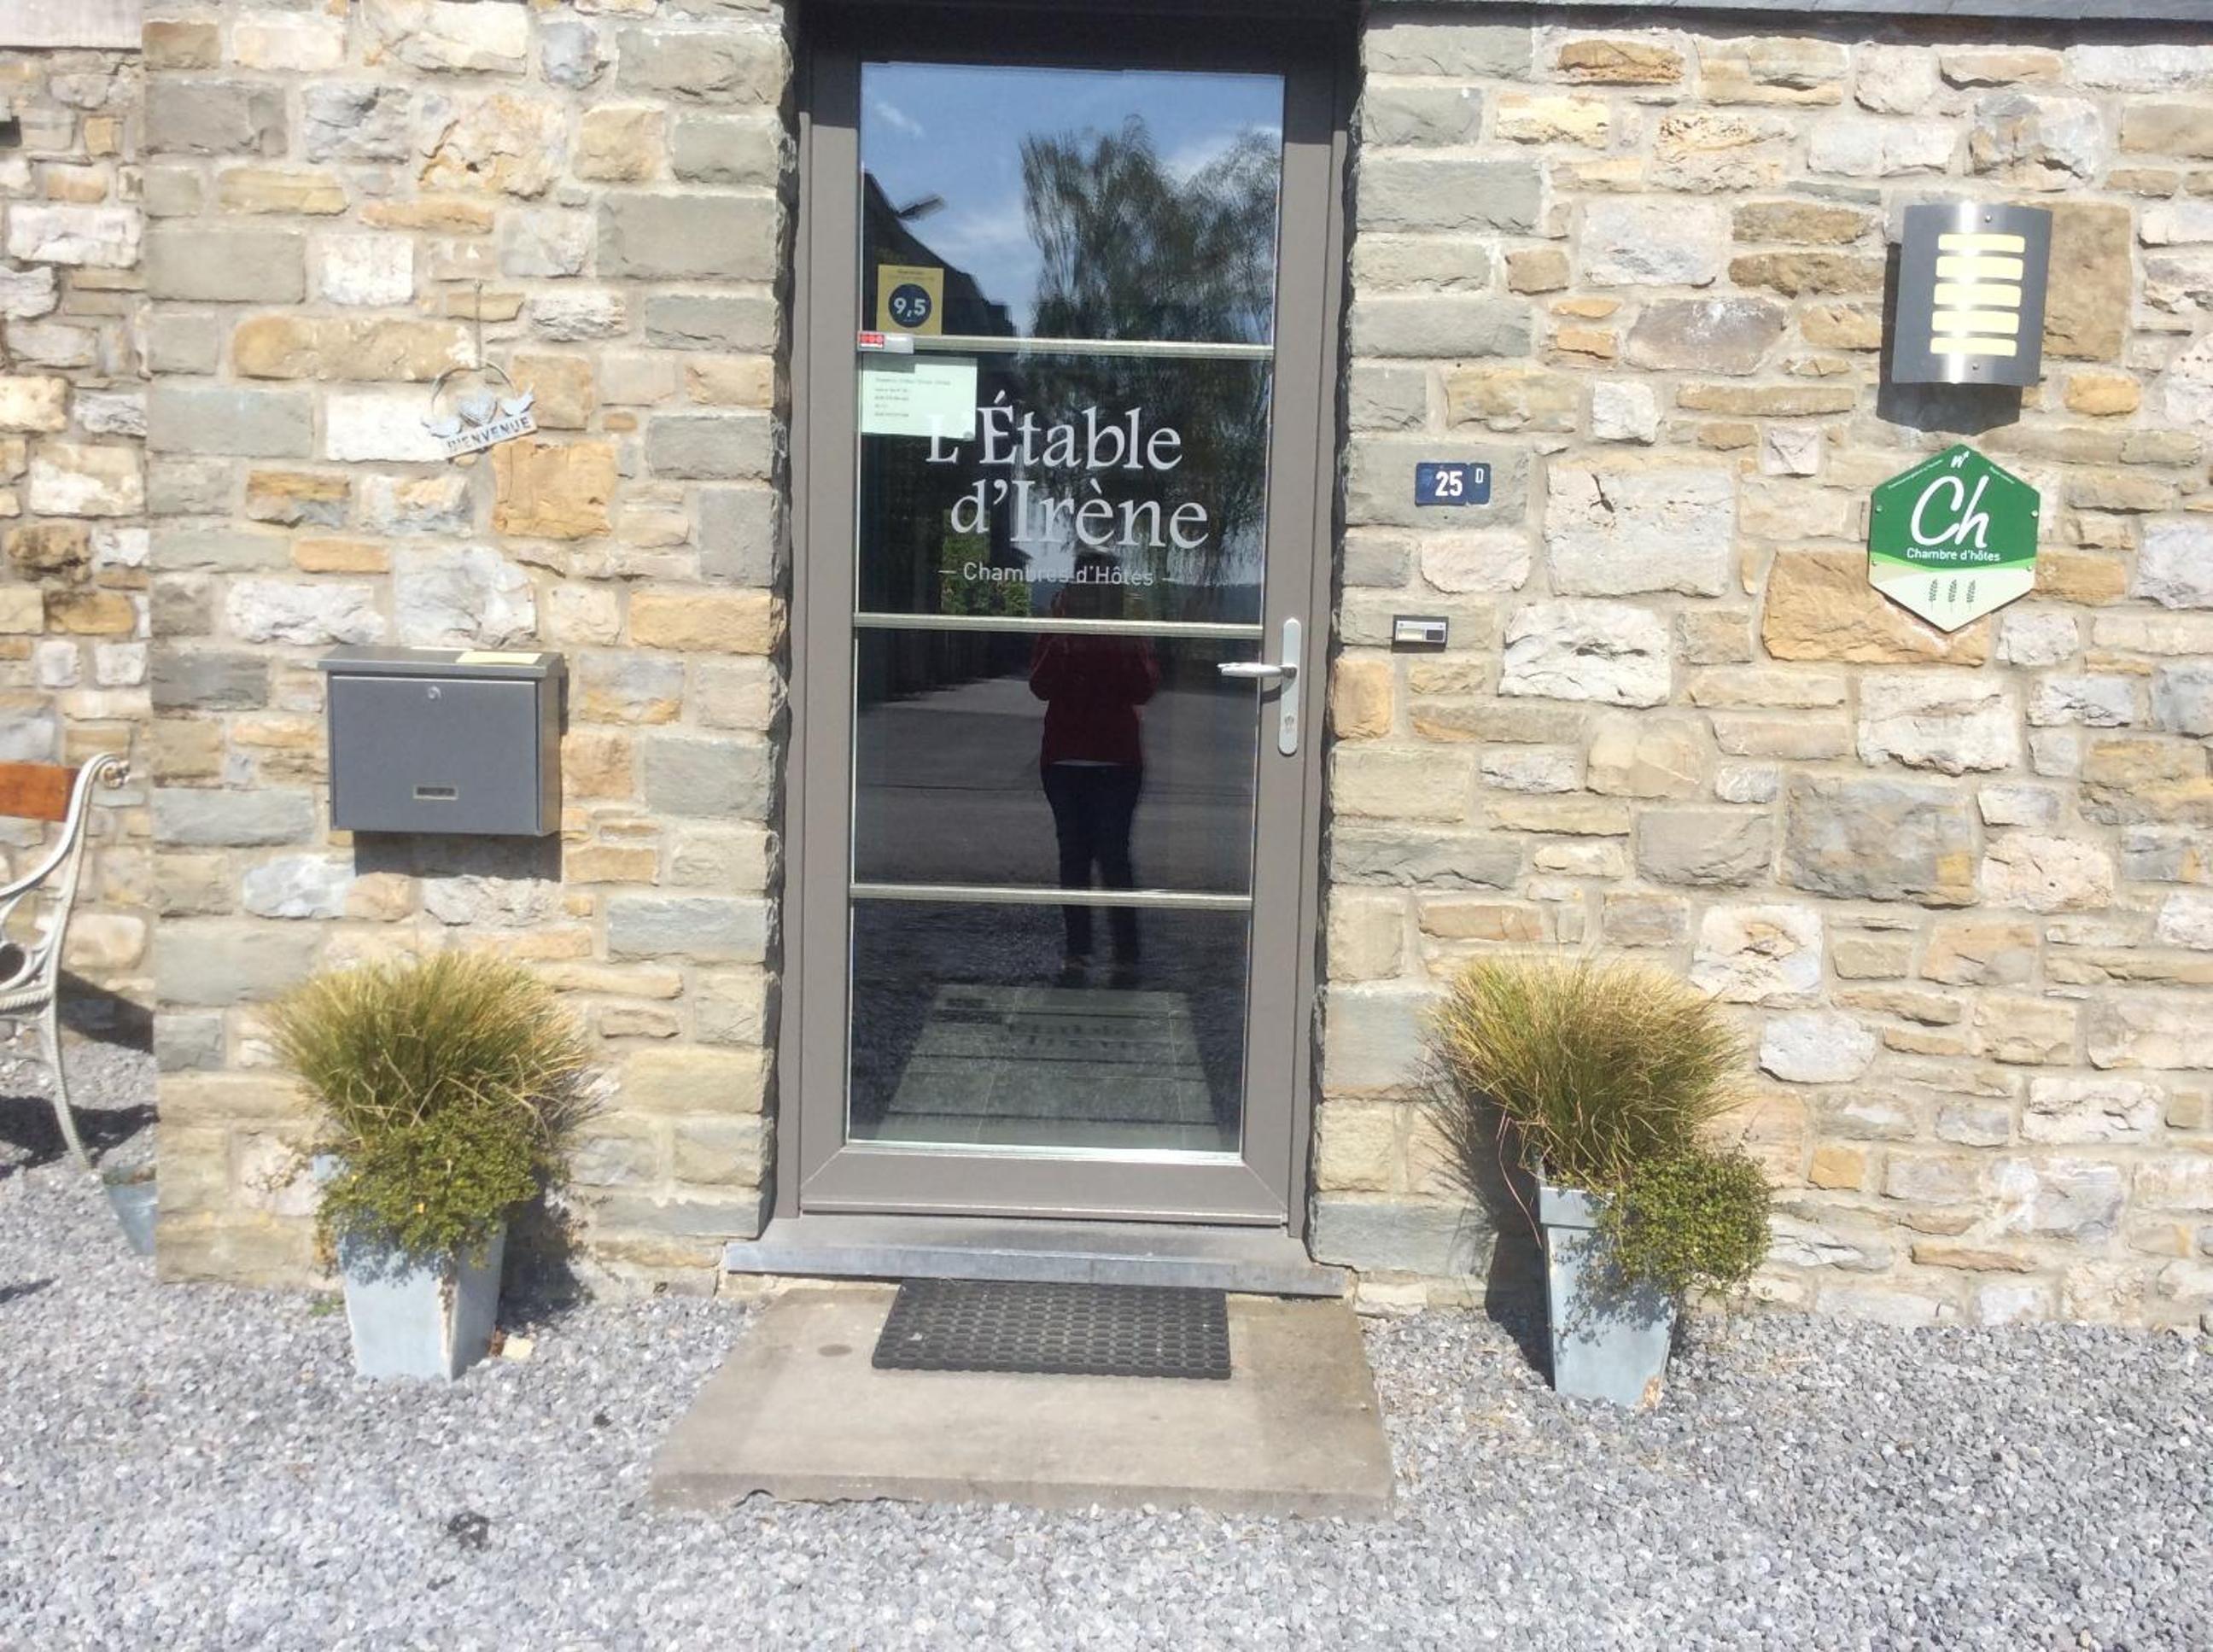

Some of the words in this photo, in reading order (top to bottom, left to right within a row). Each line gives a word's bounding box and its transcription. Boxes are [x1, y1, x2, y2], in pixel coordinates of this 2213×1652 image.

[893, 297, 926, 318] 9,5
[1435, 471, 1463, 497] 25
[1474, 468, 1484, 484] D
[950, 478, 1209, 549] d'Irène
[1911, 475, 1989, 548] Ch
[1906, 547, 1957, 561] Chambre
[1959, 549, 2001, 562] d'hôtes
[963, 562, 1069, 583] Chambres
[1076, 564, 1153, 587] d'Hôtes
